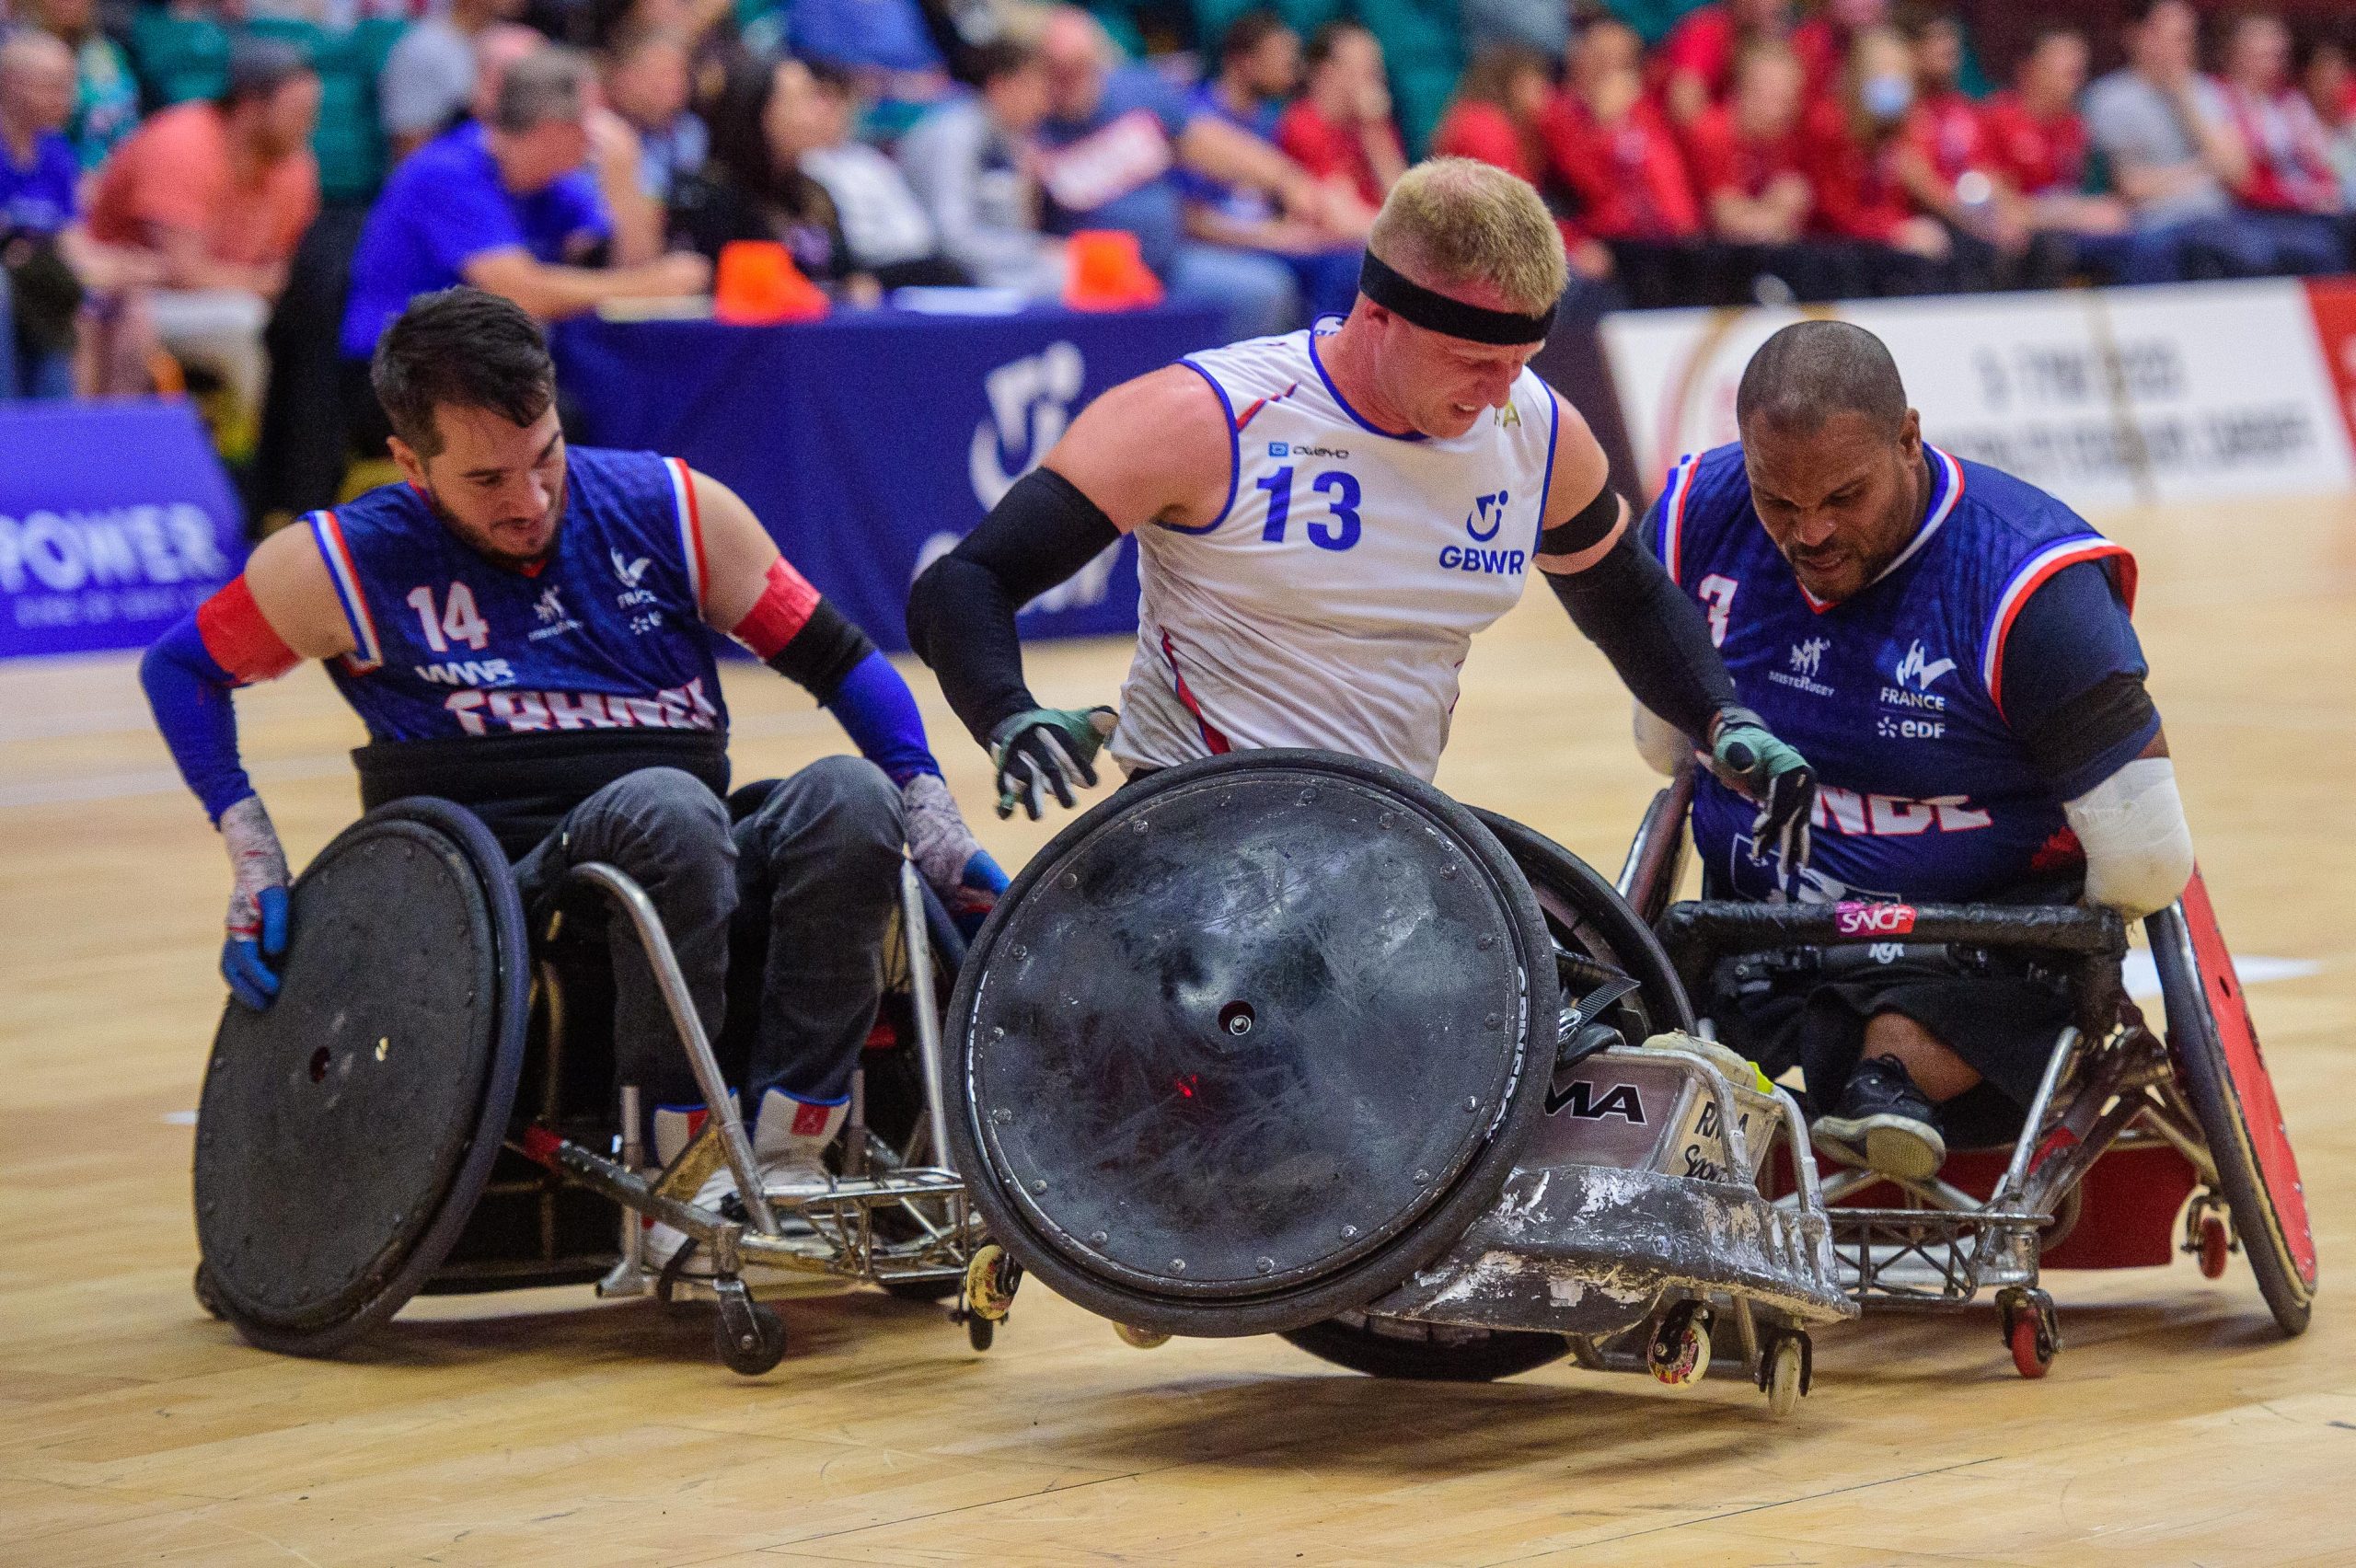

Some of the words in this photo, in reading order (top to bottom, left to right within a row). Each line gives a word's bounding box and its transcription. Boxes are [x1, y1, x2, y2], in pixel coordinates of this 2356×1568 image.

[1256, 465, 1362, 552] 13
[1438, 545, 1525, 576] GBWR
[406, 581, 490, 652] 14
[1879, 686, 1946, 711] FRANCE
[1841, 906, 1911, 933] SNCF
